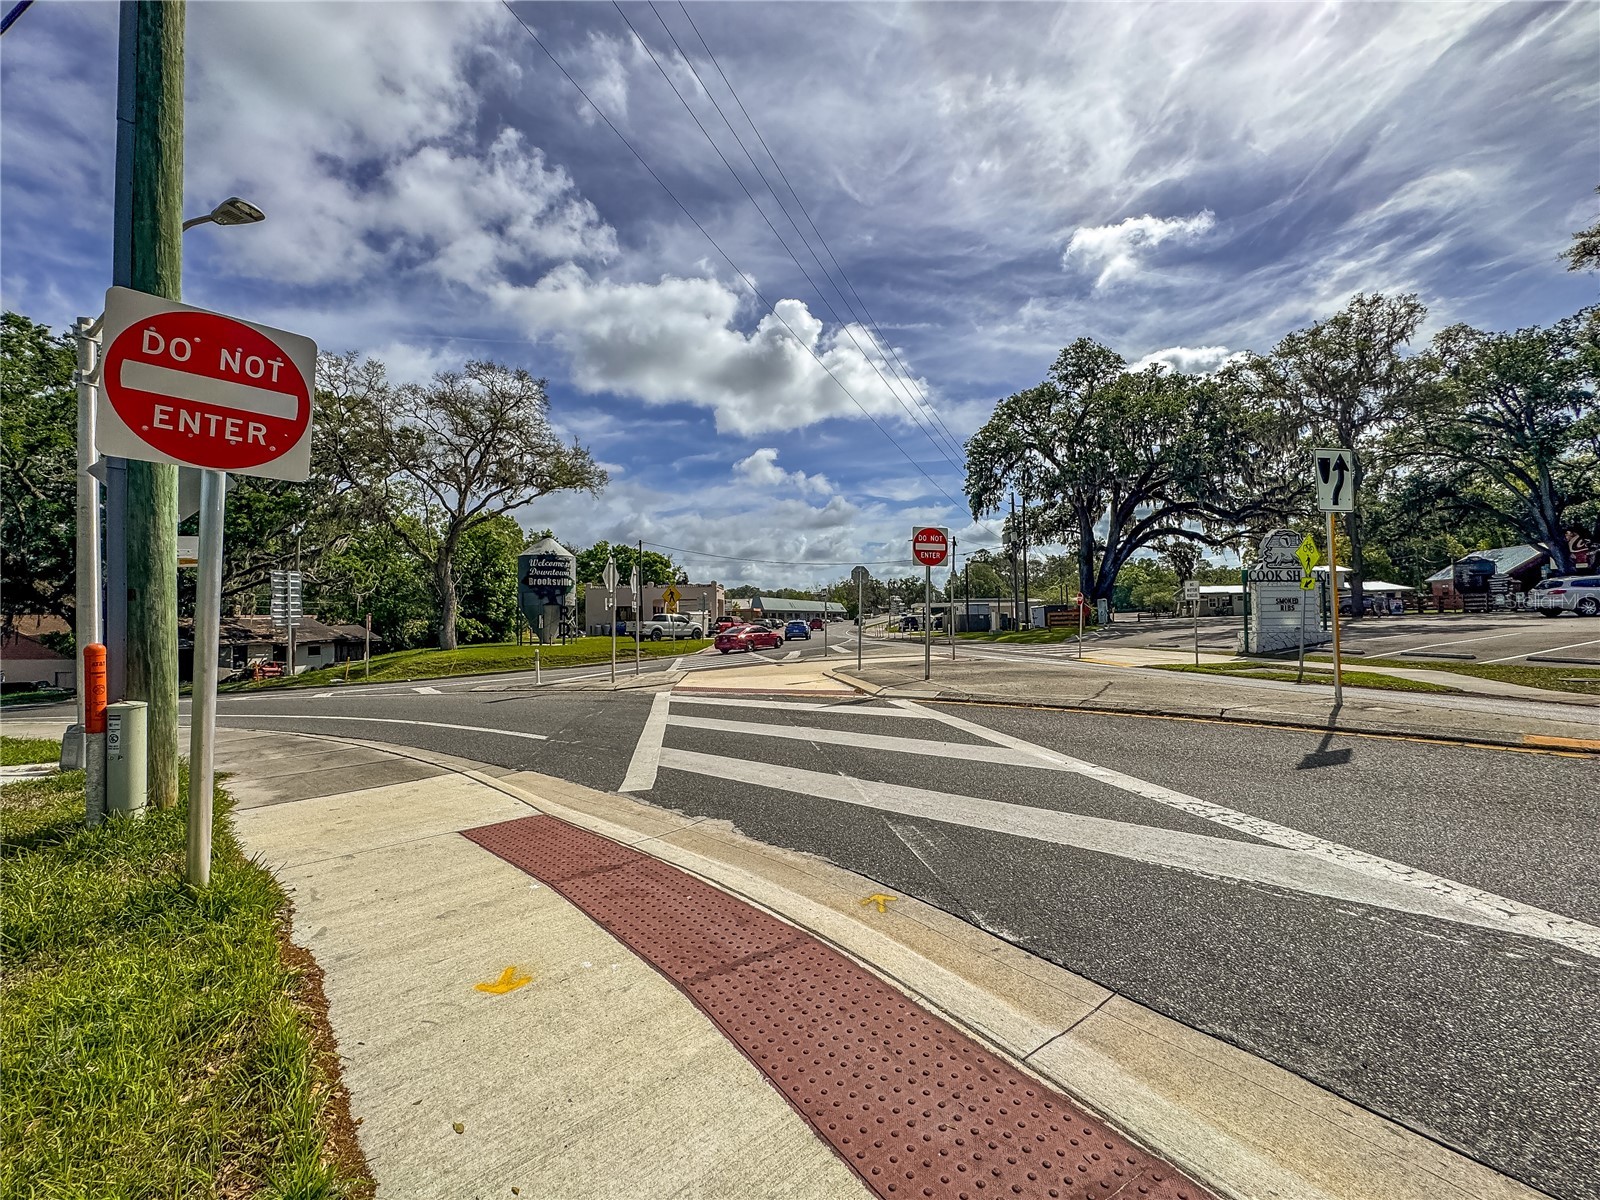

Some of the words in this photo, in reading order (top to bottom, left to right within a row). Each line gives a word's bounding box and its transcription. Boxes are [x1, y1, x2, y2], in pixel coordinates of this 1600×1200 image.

[142, 329, 192, 362] DO
[219, 349, 285, 383] NOT
[153, 404, 267, 446] ENTER
[918, 534, 927, 542] DO
[920, 551, 940, 559] ENTER
[528, 559, 564, 568] Welcome
[529, 567, 570, 576] Downtown
[1248, 570, 1282, 581] COOK
[1286, 570, 1326, 581] SHK
[528, 577, 572, 586] Brooksville
